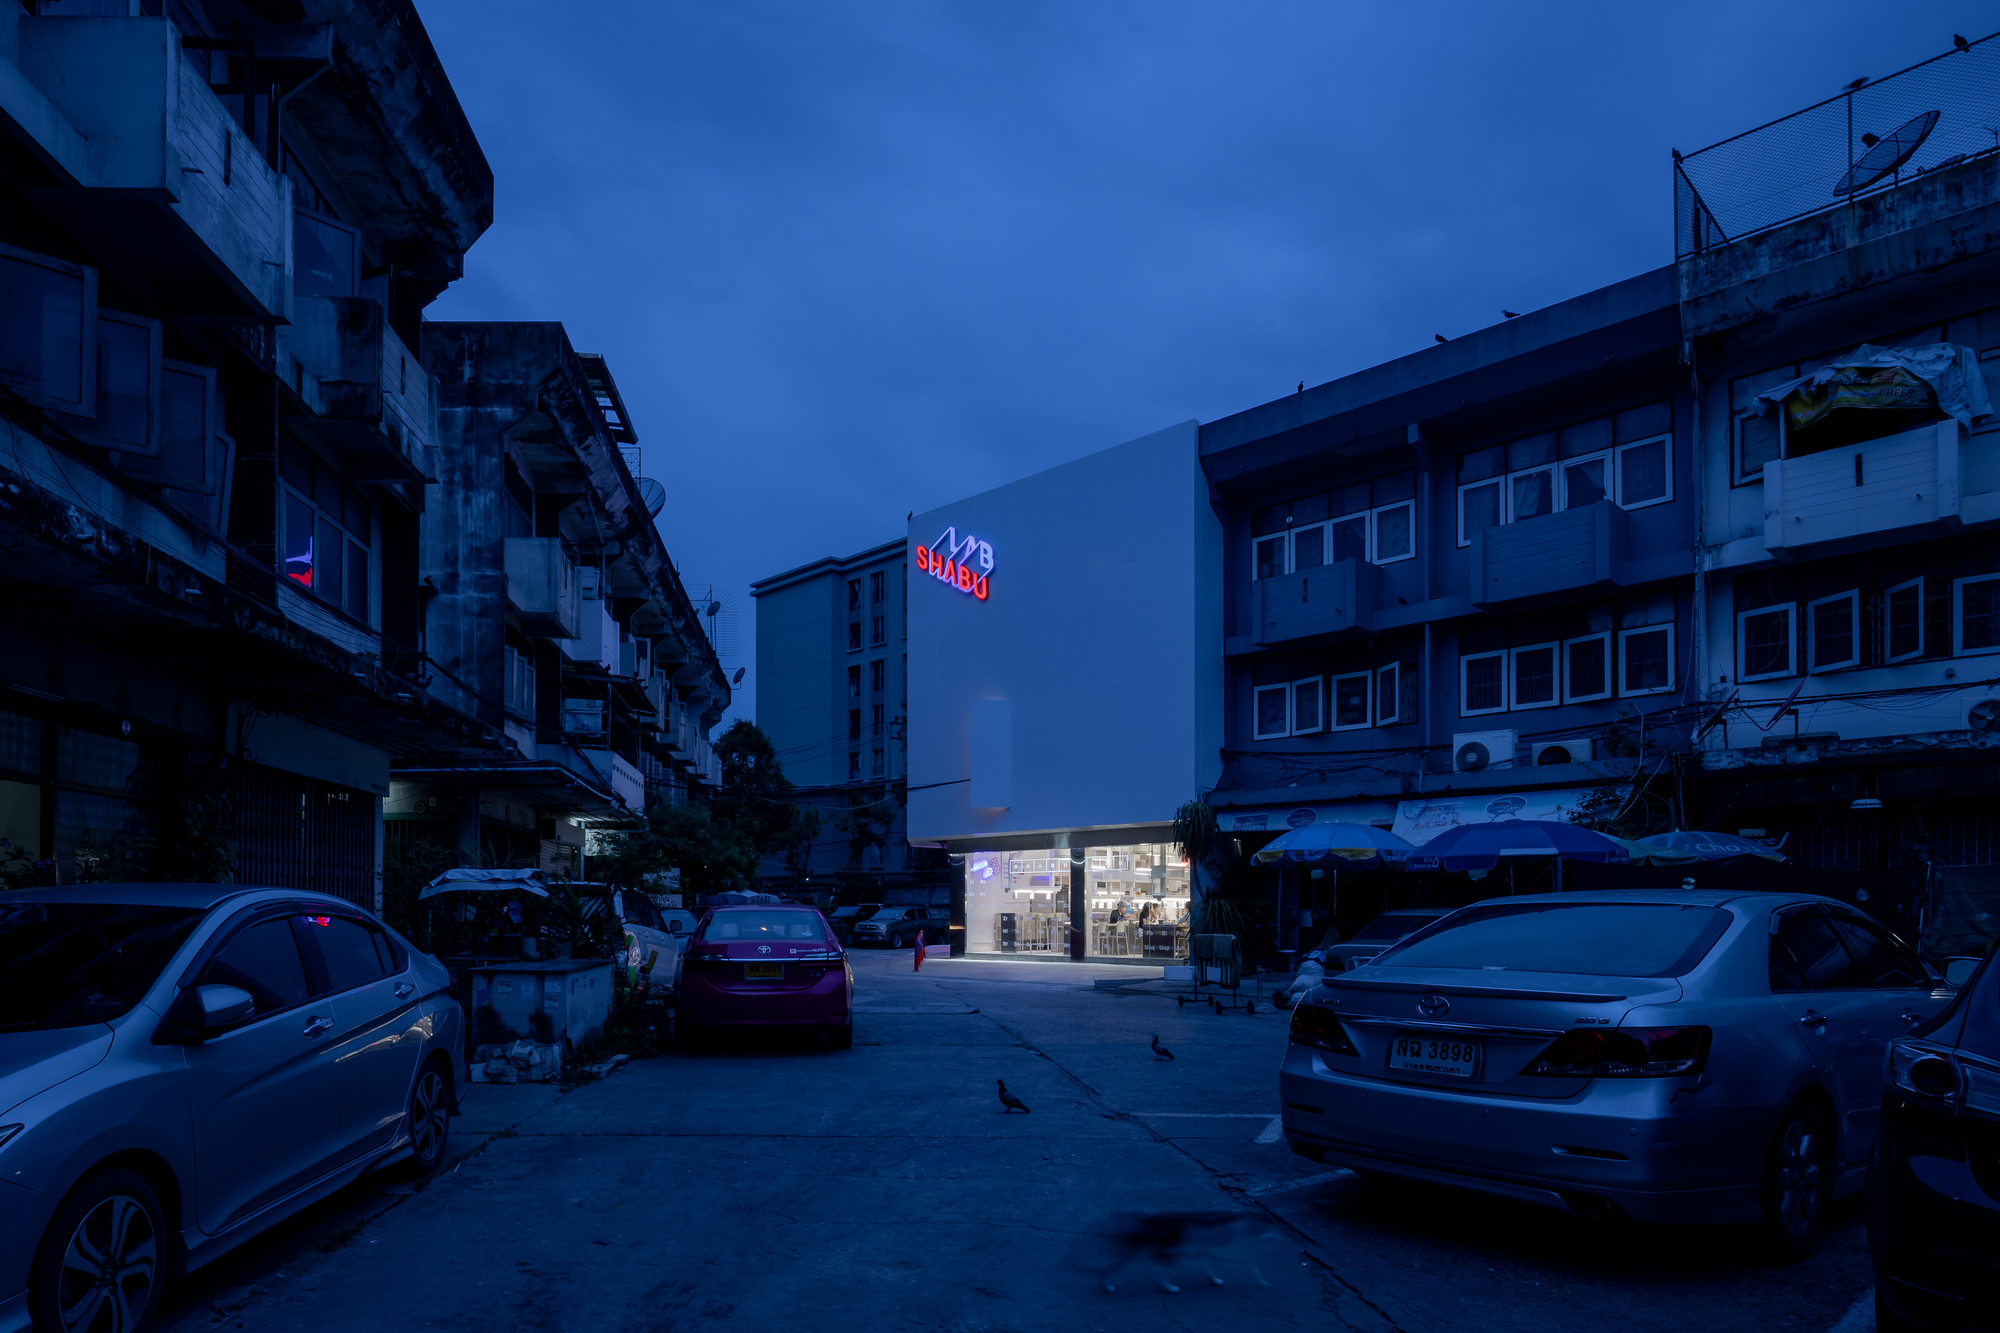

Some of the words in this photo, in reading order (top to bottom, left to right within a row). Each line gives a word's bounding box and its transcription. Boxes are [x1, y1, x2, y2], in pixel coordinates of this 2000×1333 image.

[1878, 388, 1914, 398] CHEER
[916, 545, 989, 601] SHABU
[1428, 1042, 1473, 1063] 3898
